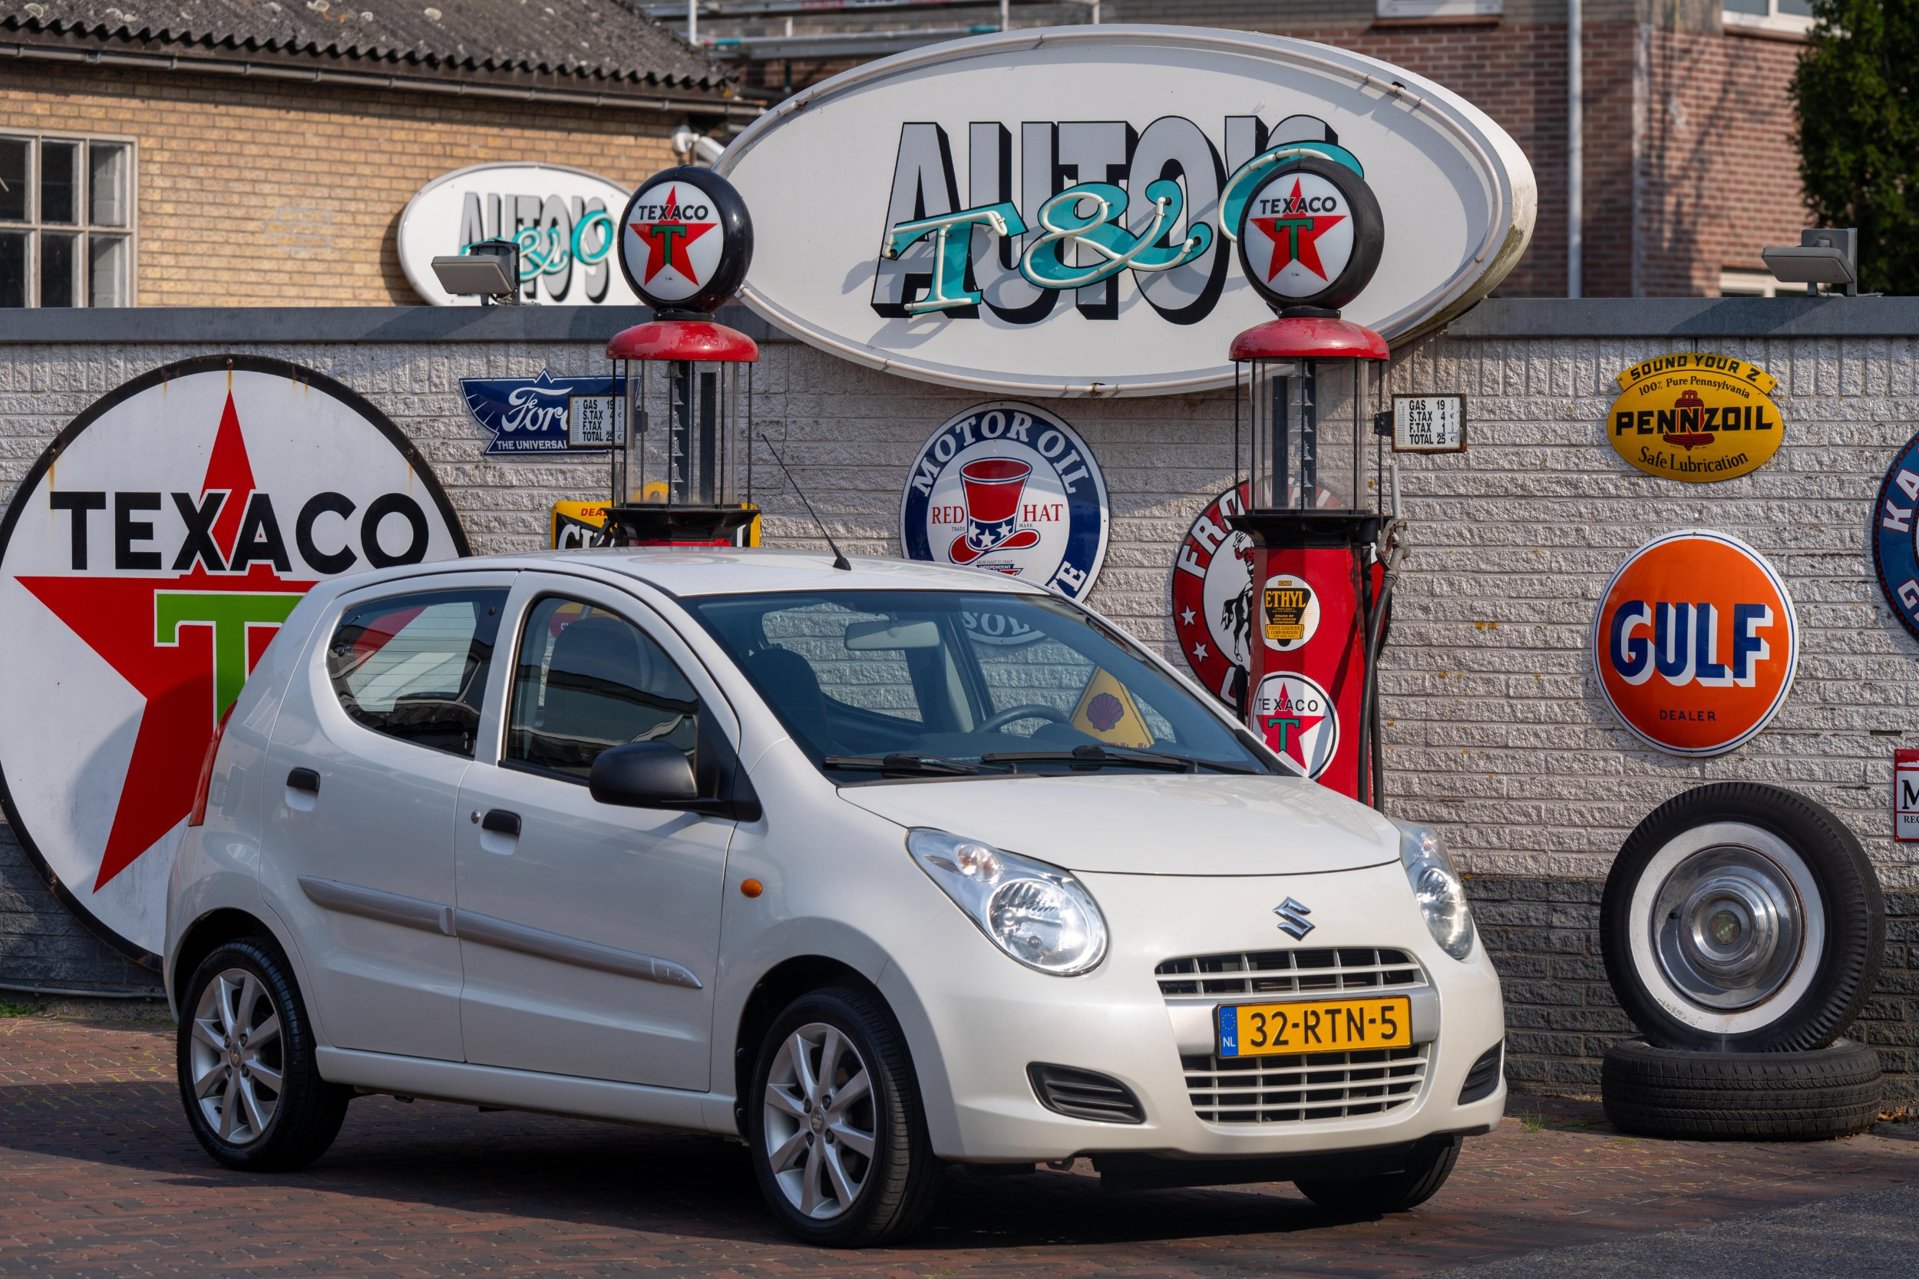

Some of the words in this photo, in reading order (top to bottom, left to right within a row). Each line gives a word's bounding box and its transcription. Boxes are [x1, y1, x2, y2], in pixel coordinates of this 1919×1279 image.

[639, 205, 708, 220] TEXACO
[1260, 197, 1337, 214] TEXACO
[651, 225, 686, 265] T
[1275, 217, 1314, 260] T
[1630, 355, 1687, 380] SOUND
[1694, 355, 1740, 373] YOUR
[1746, 368, 1761, 382] Z
[1639, 381, 1663, 396] 100%
[1666, 377, 1688, 387] Pure
[1690, 376, 1750, 399] Pennsylvania
[583, 399, 598, 410] GAS
[1409, 399, 1426, 411] GAS
[1436, 399, 1446, 411] 19
[582, 410, 604, 420] S.TAX
[1409, 411, 1433, 422] S.TAX
[1440, 411, 1446, 421] 4
[1616, 405, 1773, 436] PENNZOIL
[582, 420, 602, 431] F.TAX
[1409, 422, 1432, 433] F.TAX
[1441, 422, 1446, 433] 1
[497, 440, 514, 449] THE
[582, 431, 604, 441] TOTAL
[1409, 433, 1434, 445] TOTAL
[1436, 433, 1446, 445] 25
[912, 411, 1032, 497] MOTOR
[1037, 430, 1090, 494] OIL
[1638, 446, 1667, 469] Safe
[1671, 452, 1749, 473] Lubrication
[932, 506, 965, 524] RED
[1023, 504, 1064, 522] HAT
[50, 491, 429, 575] TEXACO
[1265, 591, 1306, 608] ETHYL
[1610, 600, 1773, 687] GULF
[1659, 709, 1716, 721] DEALER
[1251, 1006, 1398, 1048] 32-RTN-5
[1223, 1037, 1236, 1047] NL
